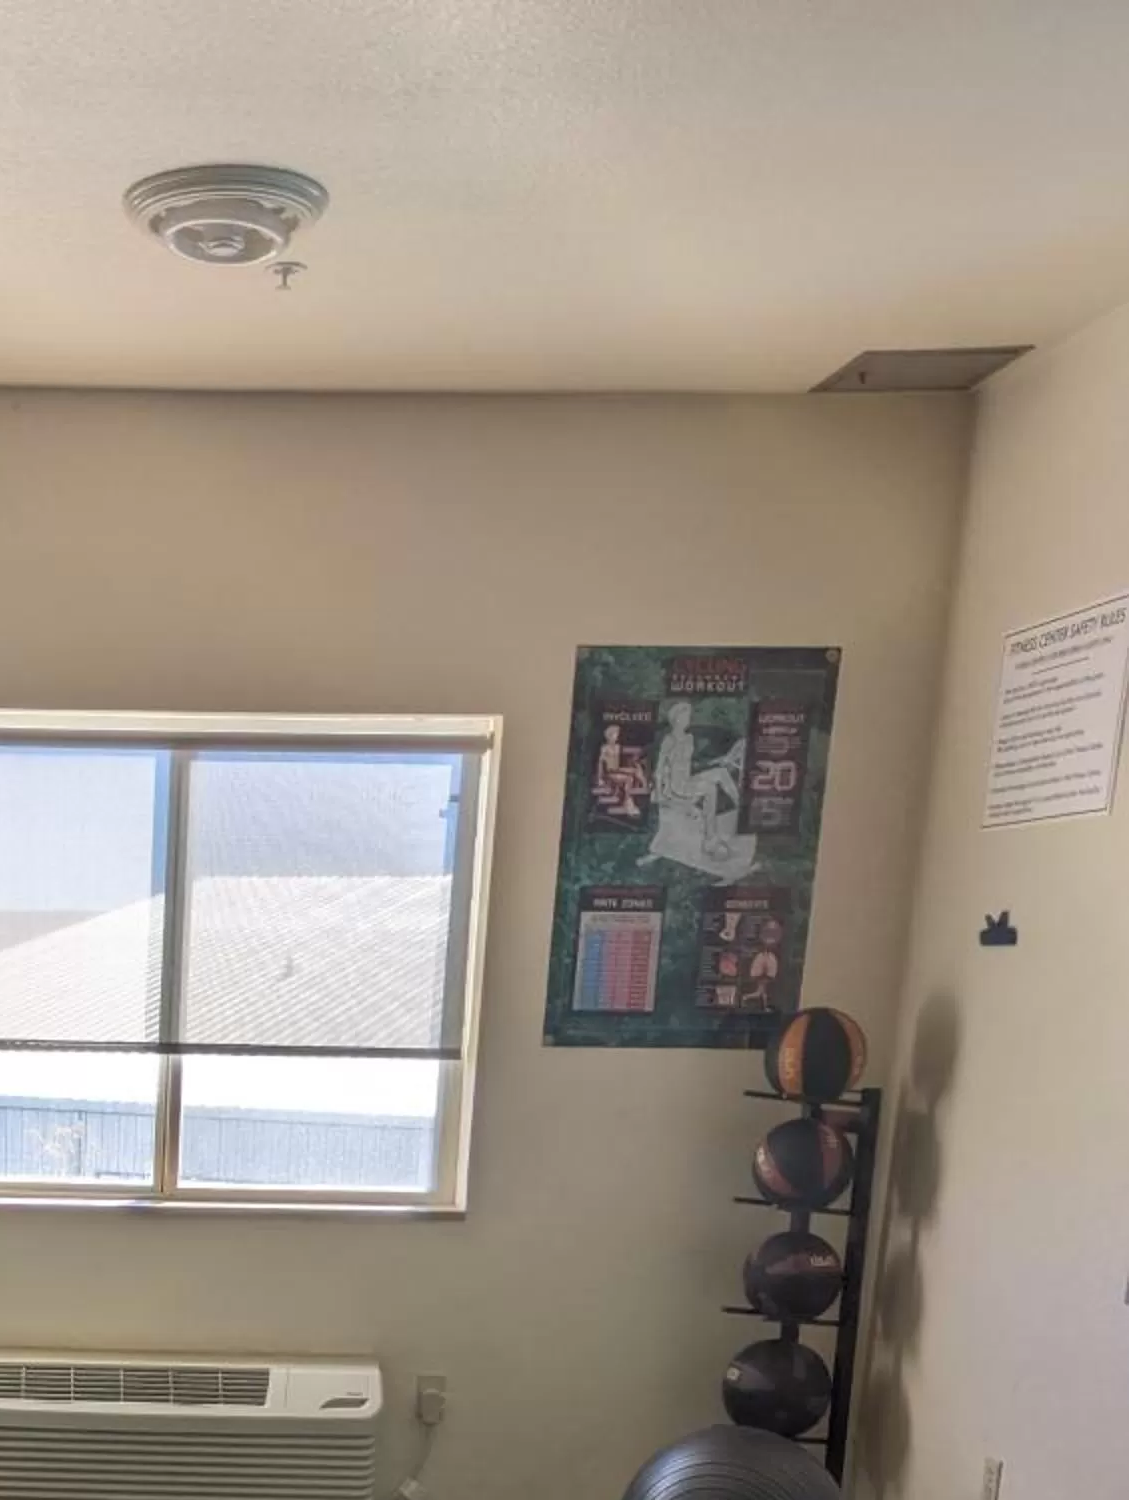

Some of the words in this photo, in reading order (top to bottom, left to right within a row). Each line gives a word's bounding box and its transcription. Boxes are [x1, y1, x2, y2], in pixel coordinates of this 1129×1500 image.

[1100, 607, 1128, 631] RULES
[670, 680, 745, 692] WORKOUT
[752, 760, 797, 792] 20
